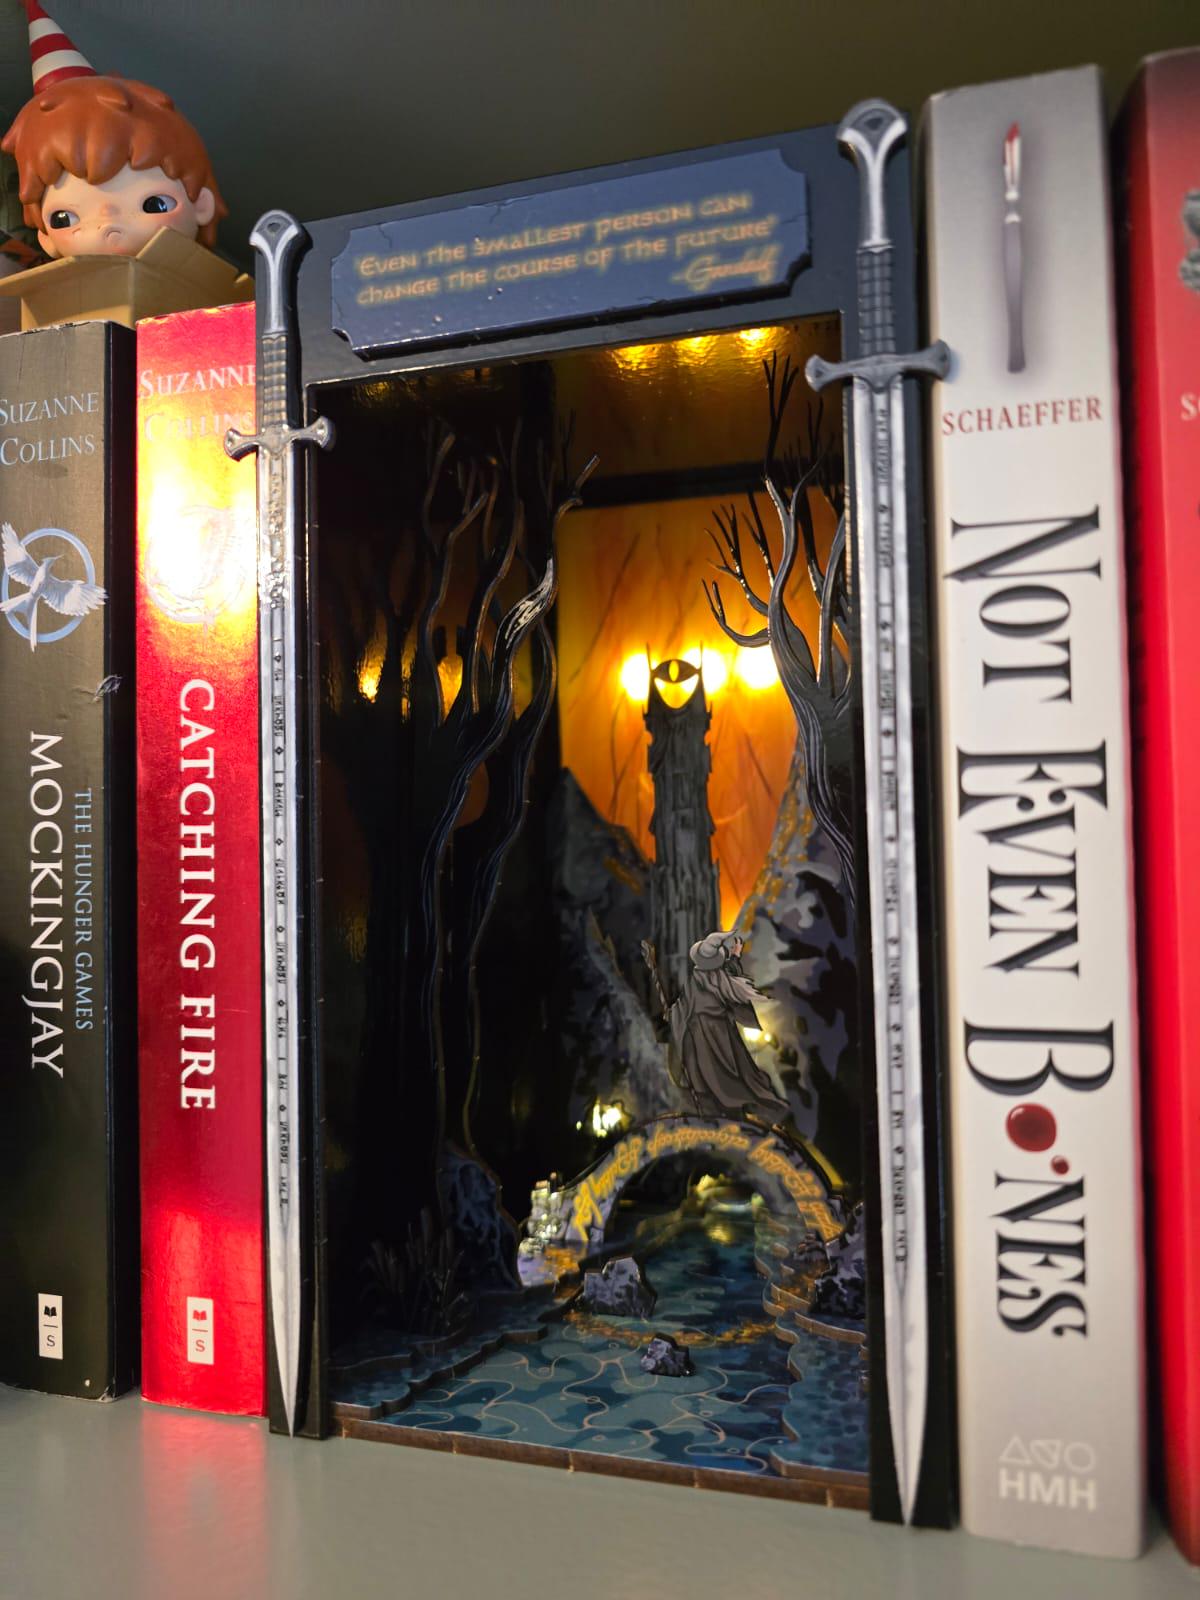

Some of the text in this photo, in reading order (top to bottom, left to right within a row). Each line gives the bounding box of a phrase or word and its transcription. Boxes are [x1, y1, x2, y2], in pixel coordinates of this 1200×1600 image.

[0, 434, 96, 466] COLLINS
[942, 397, 1103, 436] SCHAEFFER
[942, 504, 1102, 704] NOT
[22, 731, 65, 1079] MOCKINGJAY
[74, 788, 94, 1031] THE HUNGER GAMES
[180, 679, 216, 1110] CATCHING FIRE
[957, 740, 1108, 979] EVEN
[46, 1334, 56, 1348] S
[194, 1339, 206, 1353] S
[999, 1467, 1097, 1513] HMH
